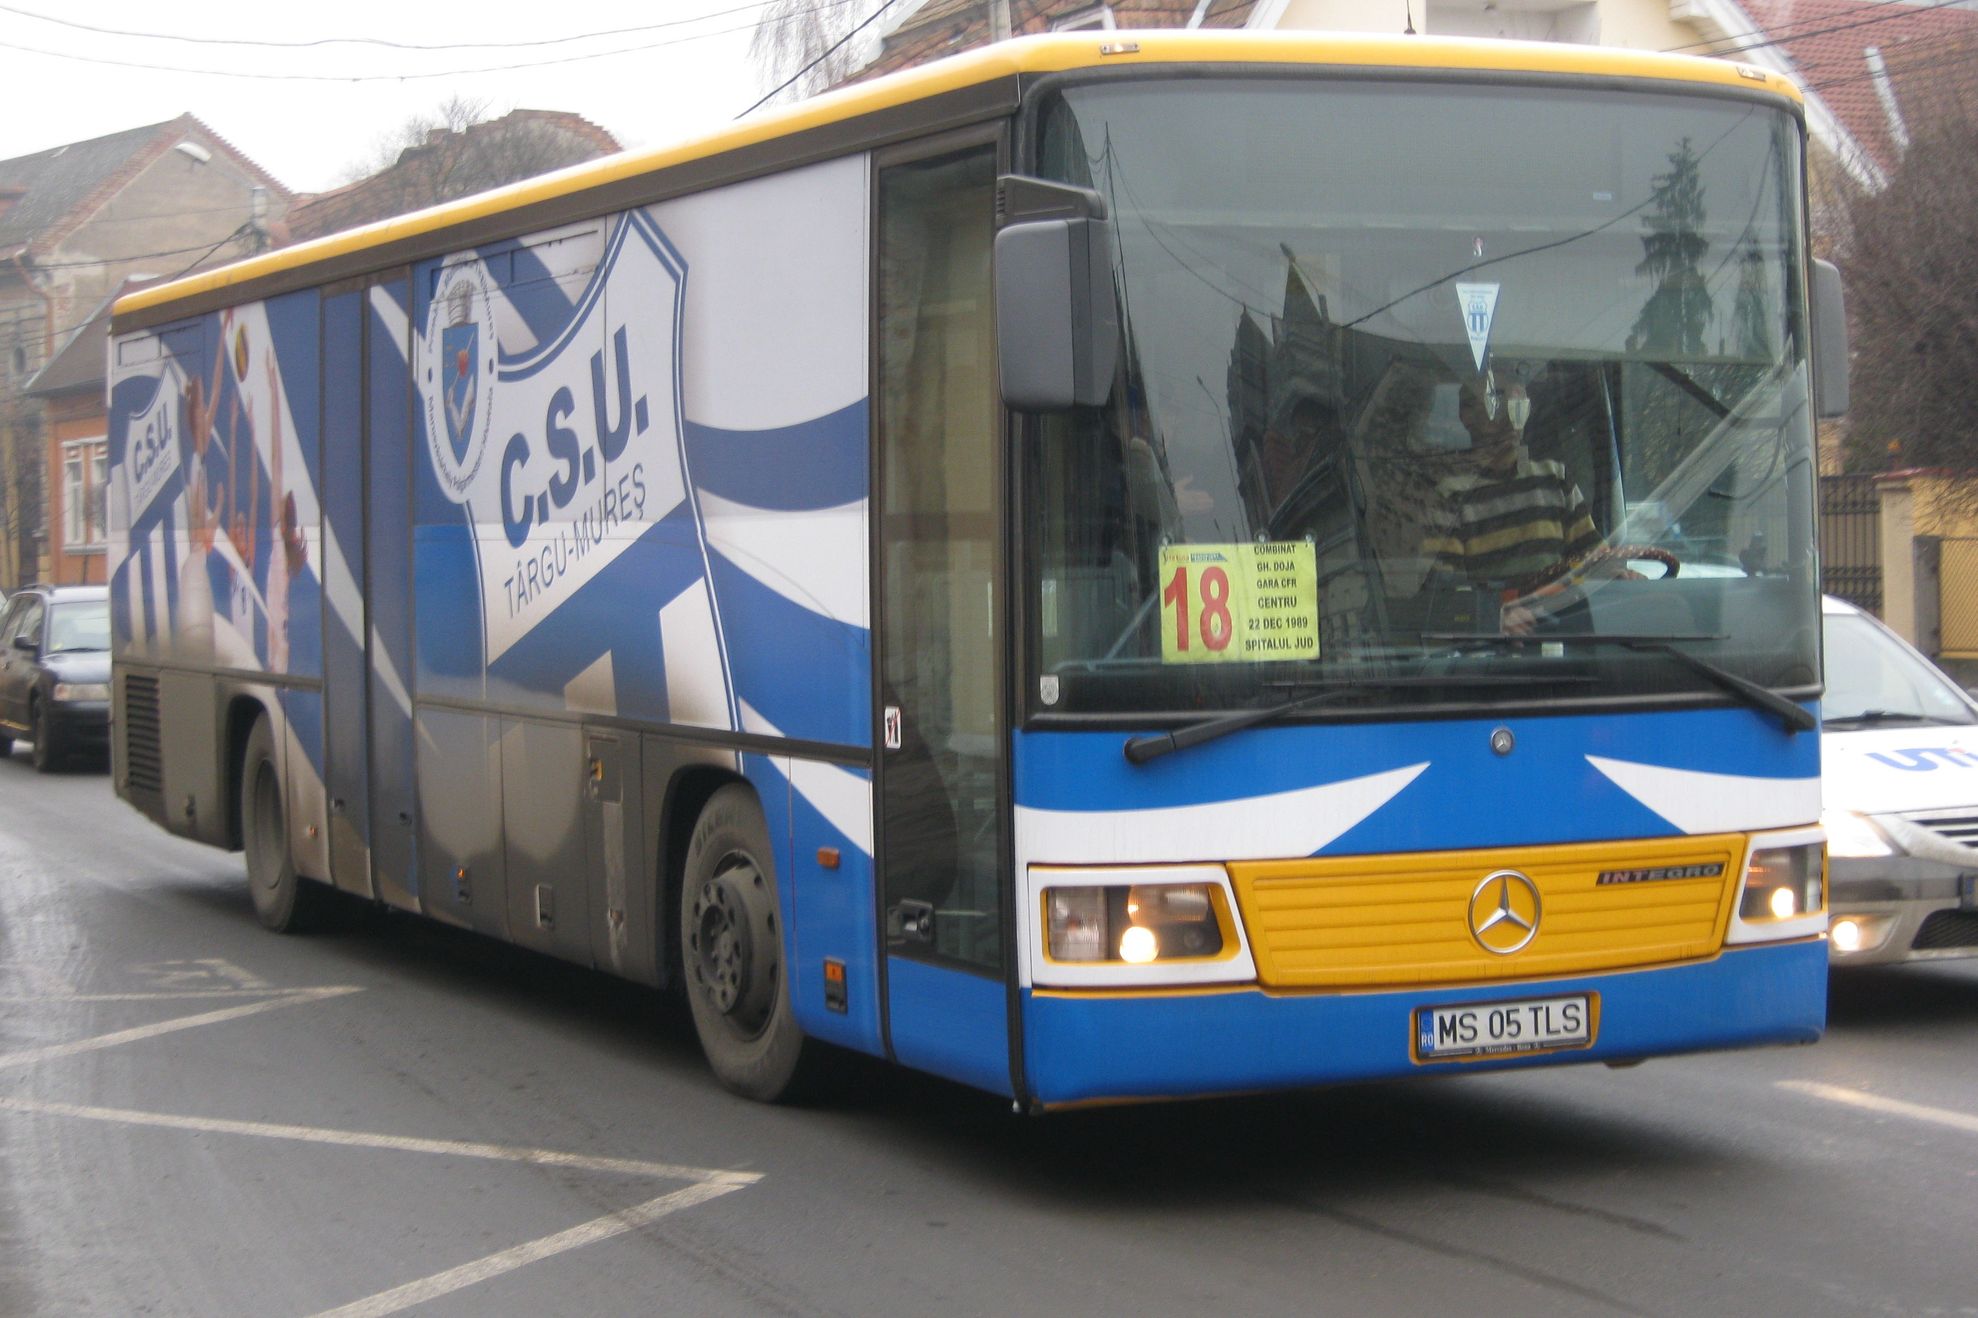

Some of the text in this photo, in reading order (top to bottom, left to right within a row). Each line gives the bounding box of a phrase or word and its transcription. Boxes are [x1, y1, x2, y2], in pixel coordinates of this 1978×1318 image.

[501, 324, 649, 548] C.S.U.
[1254, 544, 1296, 555] COMBINAT
[1257, 562, 1295, 572] GH. DOJA
[1257, 578, 1297, 589] GARA CFR
[1258, 595, 1297, 609] CENTRU
[1164, 566, 1233, 653] 18
[1249, 616, 1308, 630] 22 DEC 1989
[1245, 637, 1314, 651] SPITALUL JUD
[1602, 864, 1721, 885] INTEGRO
[1438, 1004, 1581, 1045] MS 05 TLS
